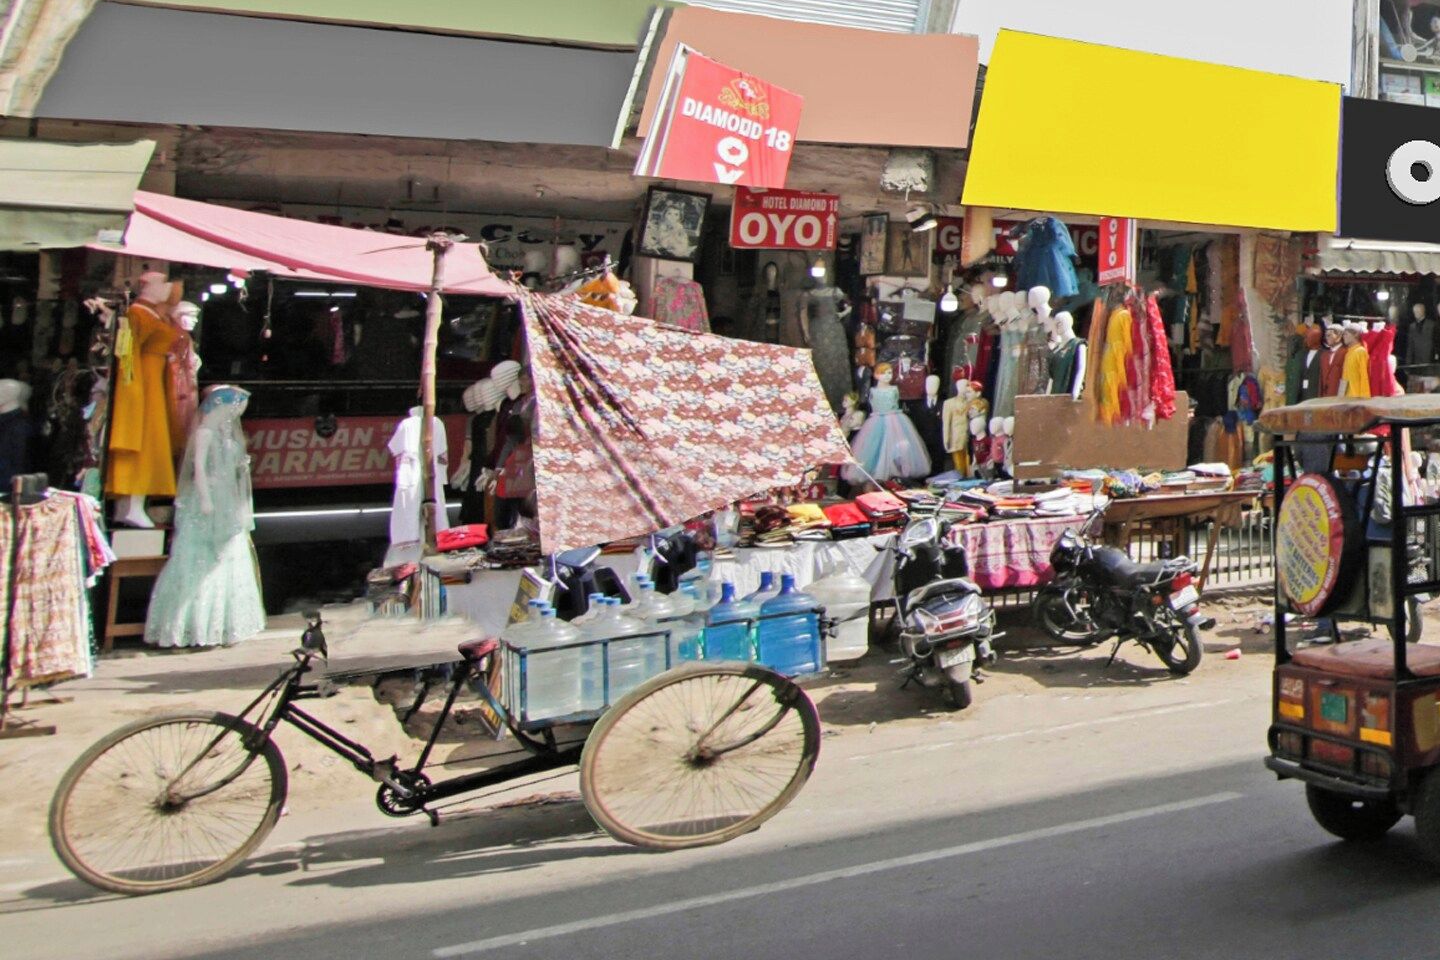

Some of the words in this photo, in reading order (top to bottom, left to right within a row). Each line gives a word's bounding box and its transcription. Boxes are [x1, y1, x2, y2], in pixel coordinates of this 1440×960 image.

[764, 125, 792, 152] 18
[762, 195, 788, 210] HOTEL
[789, 197, 827, 212] DIAMOND
[739, 212, 822, 247] OYO
[1108, 218, 1118, 267] OYO
